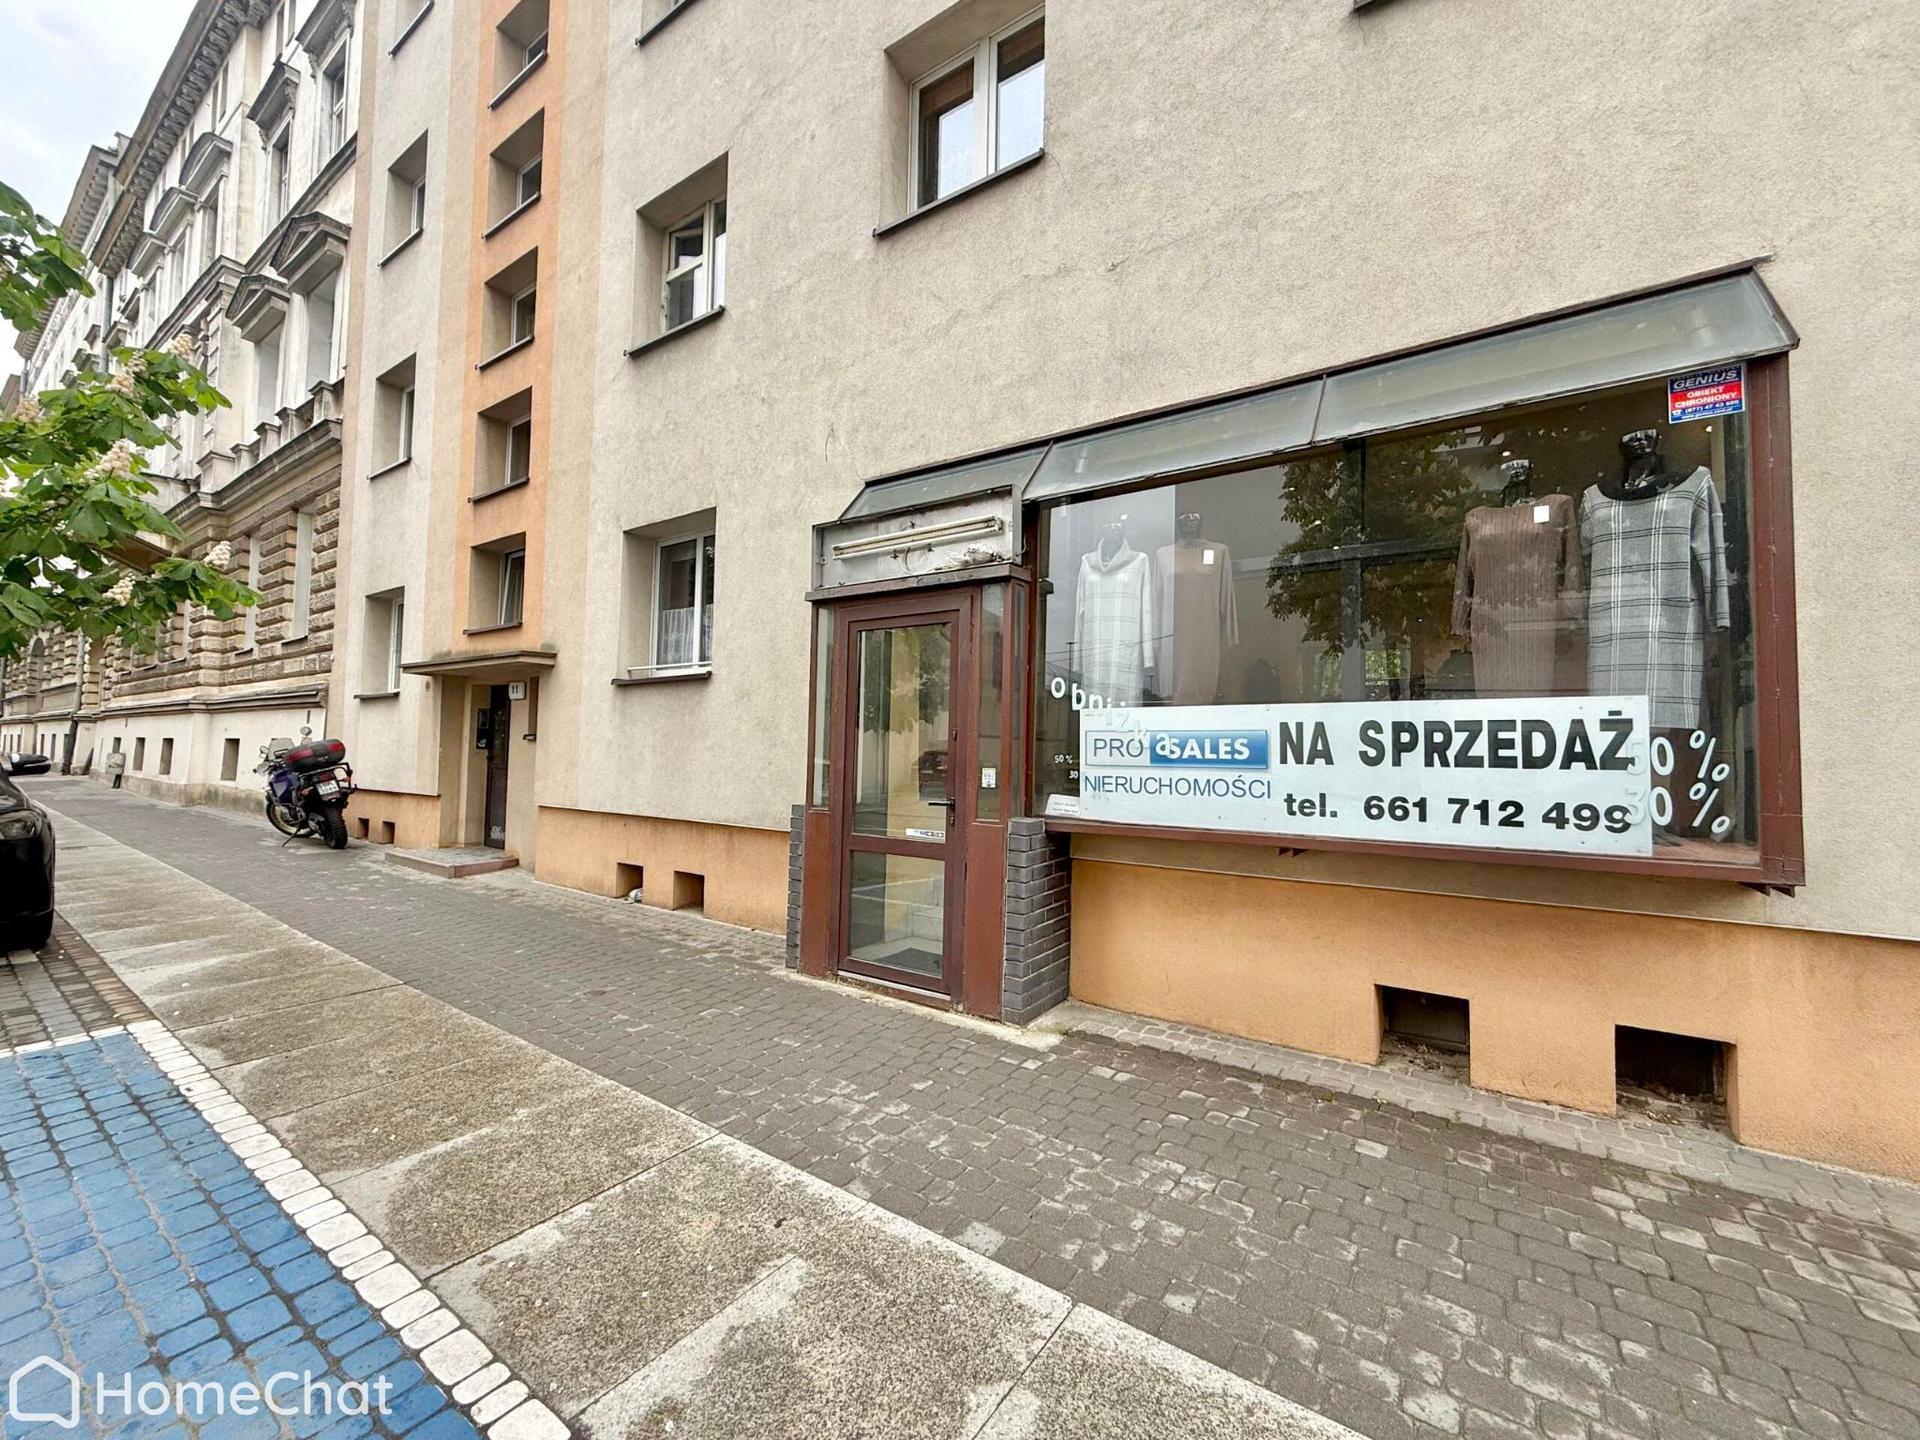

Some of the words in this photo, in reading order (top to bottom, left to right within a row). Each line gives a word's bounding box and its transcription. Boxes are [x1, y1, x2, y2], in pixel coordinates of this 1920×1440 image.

[1673, 369, 1738, 390] GENIUS
[1674, 391, 1738, 409] CHRONIONY
[1686, 385, 1725, 399] OBIEKT
[1093, 738, 1144, 758] PRO
[1167, 737, 1250, 760] SALES
[1279, 721, 1335, 766] NA
[1358, 709, 1635, 771] SPRZEDAŻ
[1068, 770, 1079, 779] 30
[1084, 775, 1271, 799] NIERUCHOMOŚCI
[1284, 793, 1338, 818] tel.
[1363, 795, 1427, 823] 661
[1448, 797, 1525, 828] 712
[1542, 802, 1632, 833] 499
